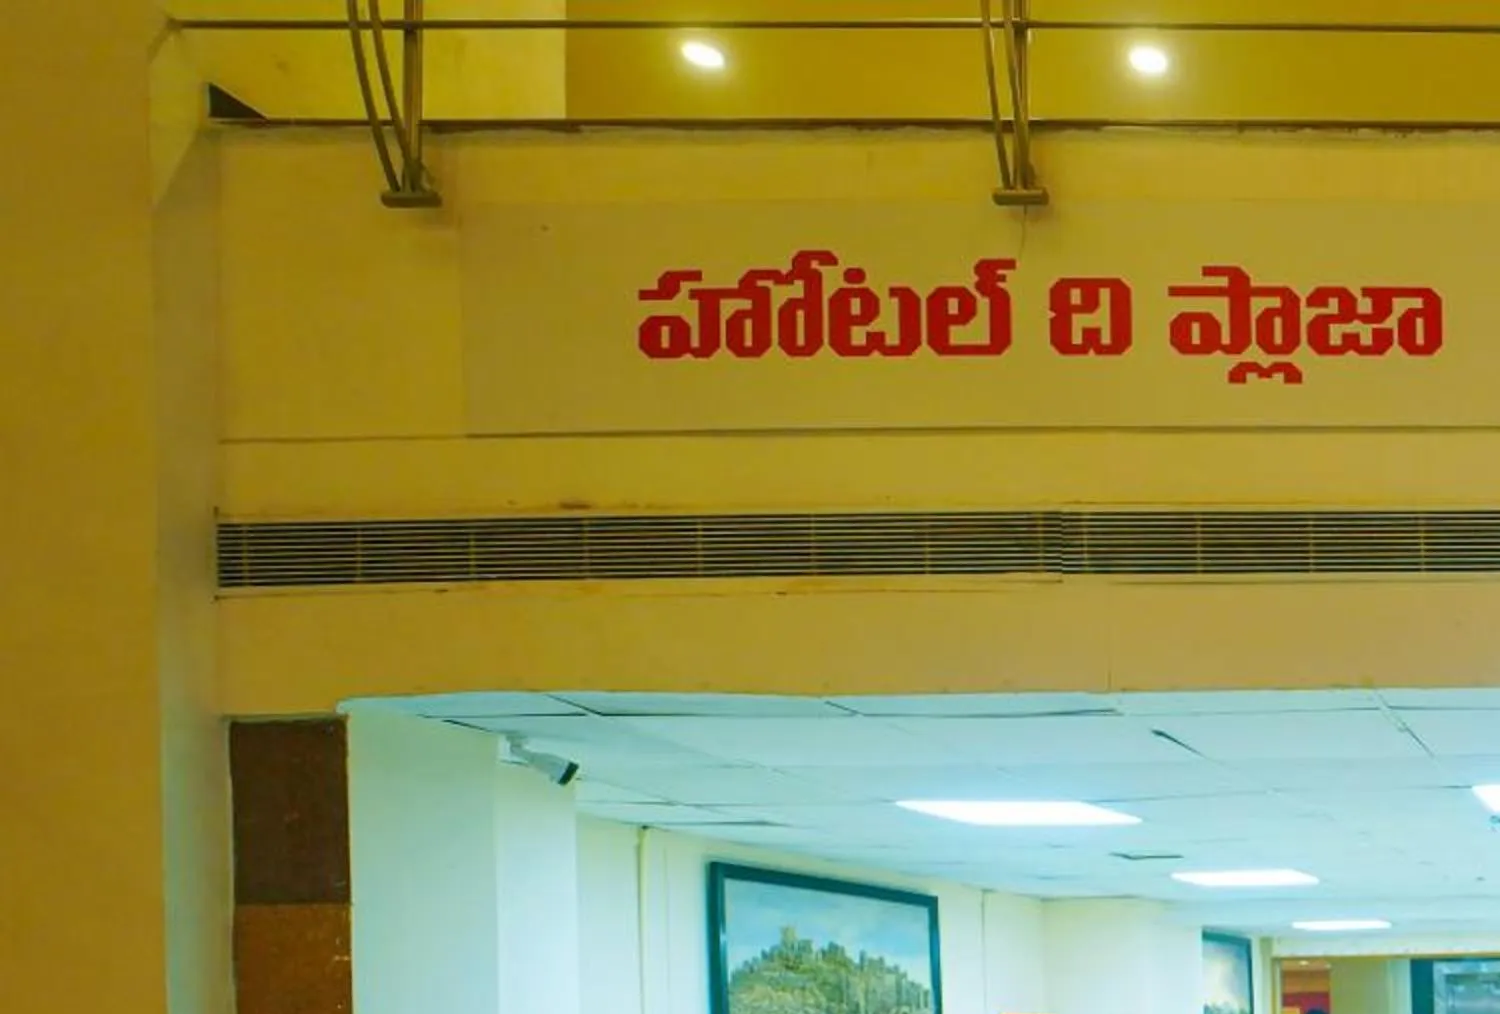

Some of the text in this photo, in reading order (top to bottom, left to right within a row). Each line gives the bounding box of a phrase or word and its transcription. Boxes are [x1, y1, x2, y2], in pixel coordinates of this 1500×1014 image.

[638, 250, 1443, 384] హోటల్ ది ప్లాజా
